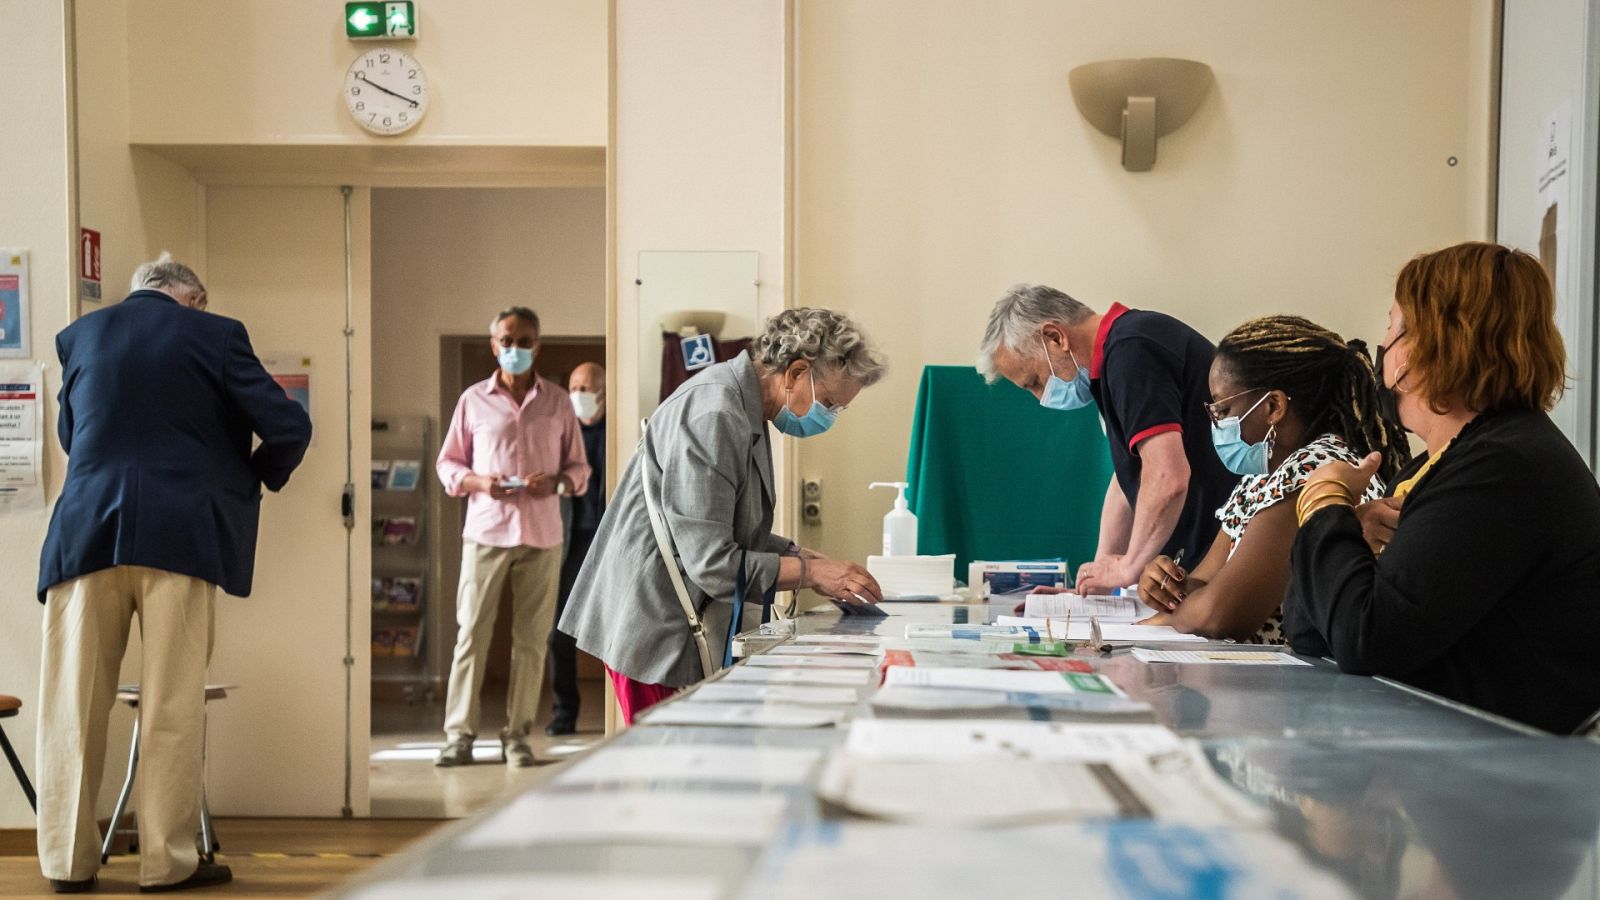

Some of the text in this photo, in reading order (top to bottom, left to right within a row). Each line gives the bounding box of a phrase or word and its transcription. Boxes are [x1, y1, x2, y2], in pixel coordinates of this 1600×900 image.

[366, 59, 374, 68] 11
[379, 53, 390, 64] 12
[399, 58, 403, 67] 1
[354, 71, 366, 80] 10
[408, 69, 416, 79] 2
[351, 86, 360, 96] 9
[412, 85, 421, 95] 3
[356, 102, 365, 110] 8
[368, 112, 376, 122] 7
[382, 116, 392, 126] 6
[398, 112, 407, 122] 5
